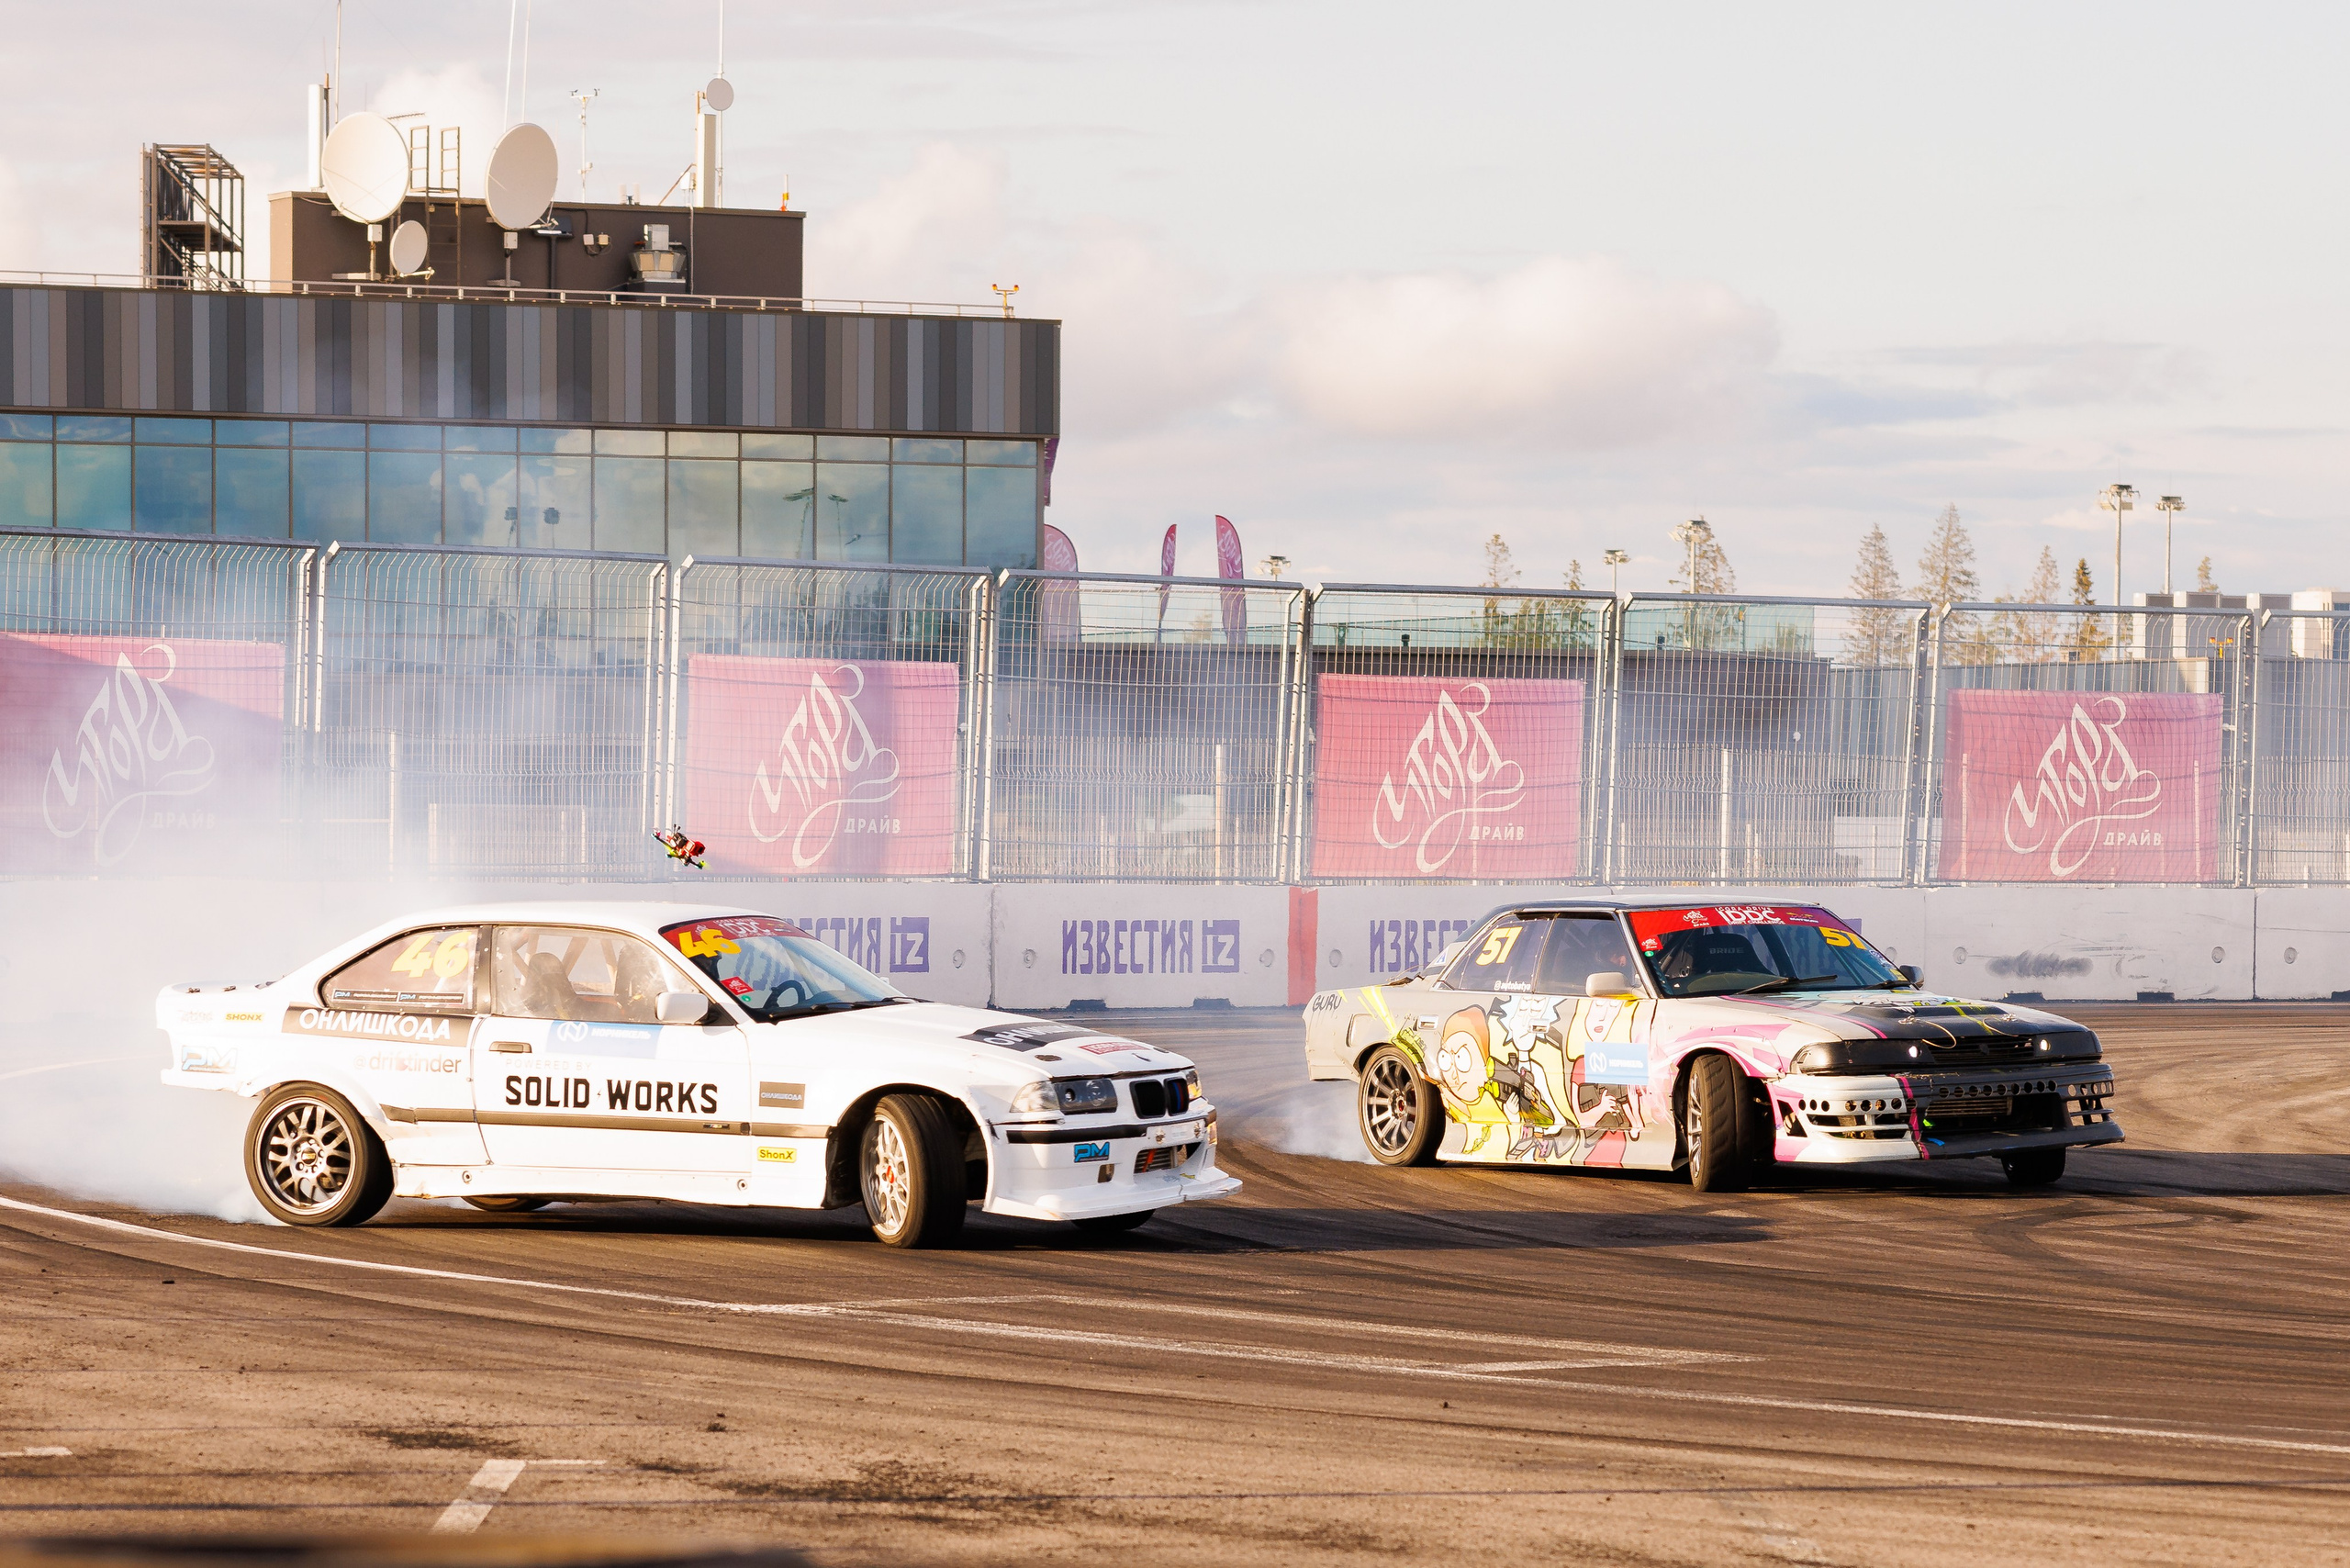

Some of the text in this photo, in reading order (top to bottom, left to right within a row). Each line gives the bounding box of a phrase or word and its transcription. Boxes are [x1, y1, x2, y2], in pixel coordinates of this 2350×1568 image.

[150, 812, 216, 831] ДРАЙВ
[844, 814, 901, 834] ДРАЙВ
[1468, 822, 1525, 841] ДРАЙВ
[2103, 828, 2163, 847] ДРАЙВ
[1718, 909, 1781, 923] IDDC
[678, 928, 742, 958] 46
[1062, 919, 1192, 974] ИЗВЕСТИЯ
[1370, 920, 1476, 973] ИЗВЕСТ
[1818, 926, 1868, 951] 51
[391, 931, 473, 978] 46
[1708, 946, 1745, 955] BRIDE
[1313, 993, 1343, 1012] GURU
[226, 1013, 263, 1021] SHONX
[299, 1009, 451, 1041] ОНЛИШКОДА
[591, 1026, 652, 1040] НОРНИКЕЛЬ
[182, 1045, 238, 1071] PM
[506, 1058, 592, 1072] POWERED BY
[506, 1075, 718, 1114] SOLID WORKS
[759, 1148, 794, 1160] ShonX
[1074, 1141, 1110, 1162] PM
